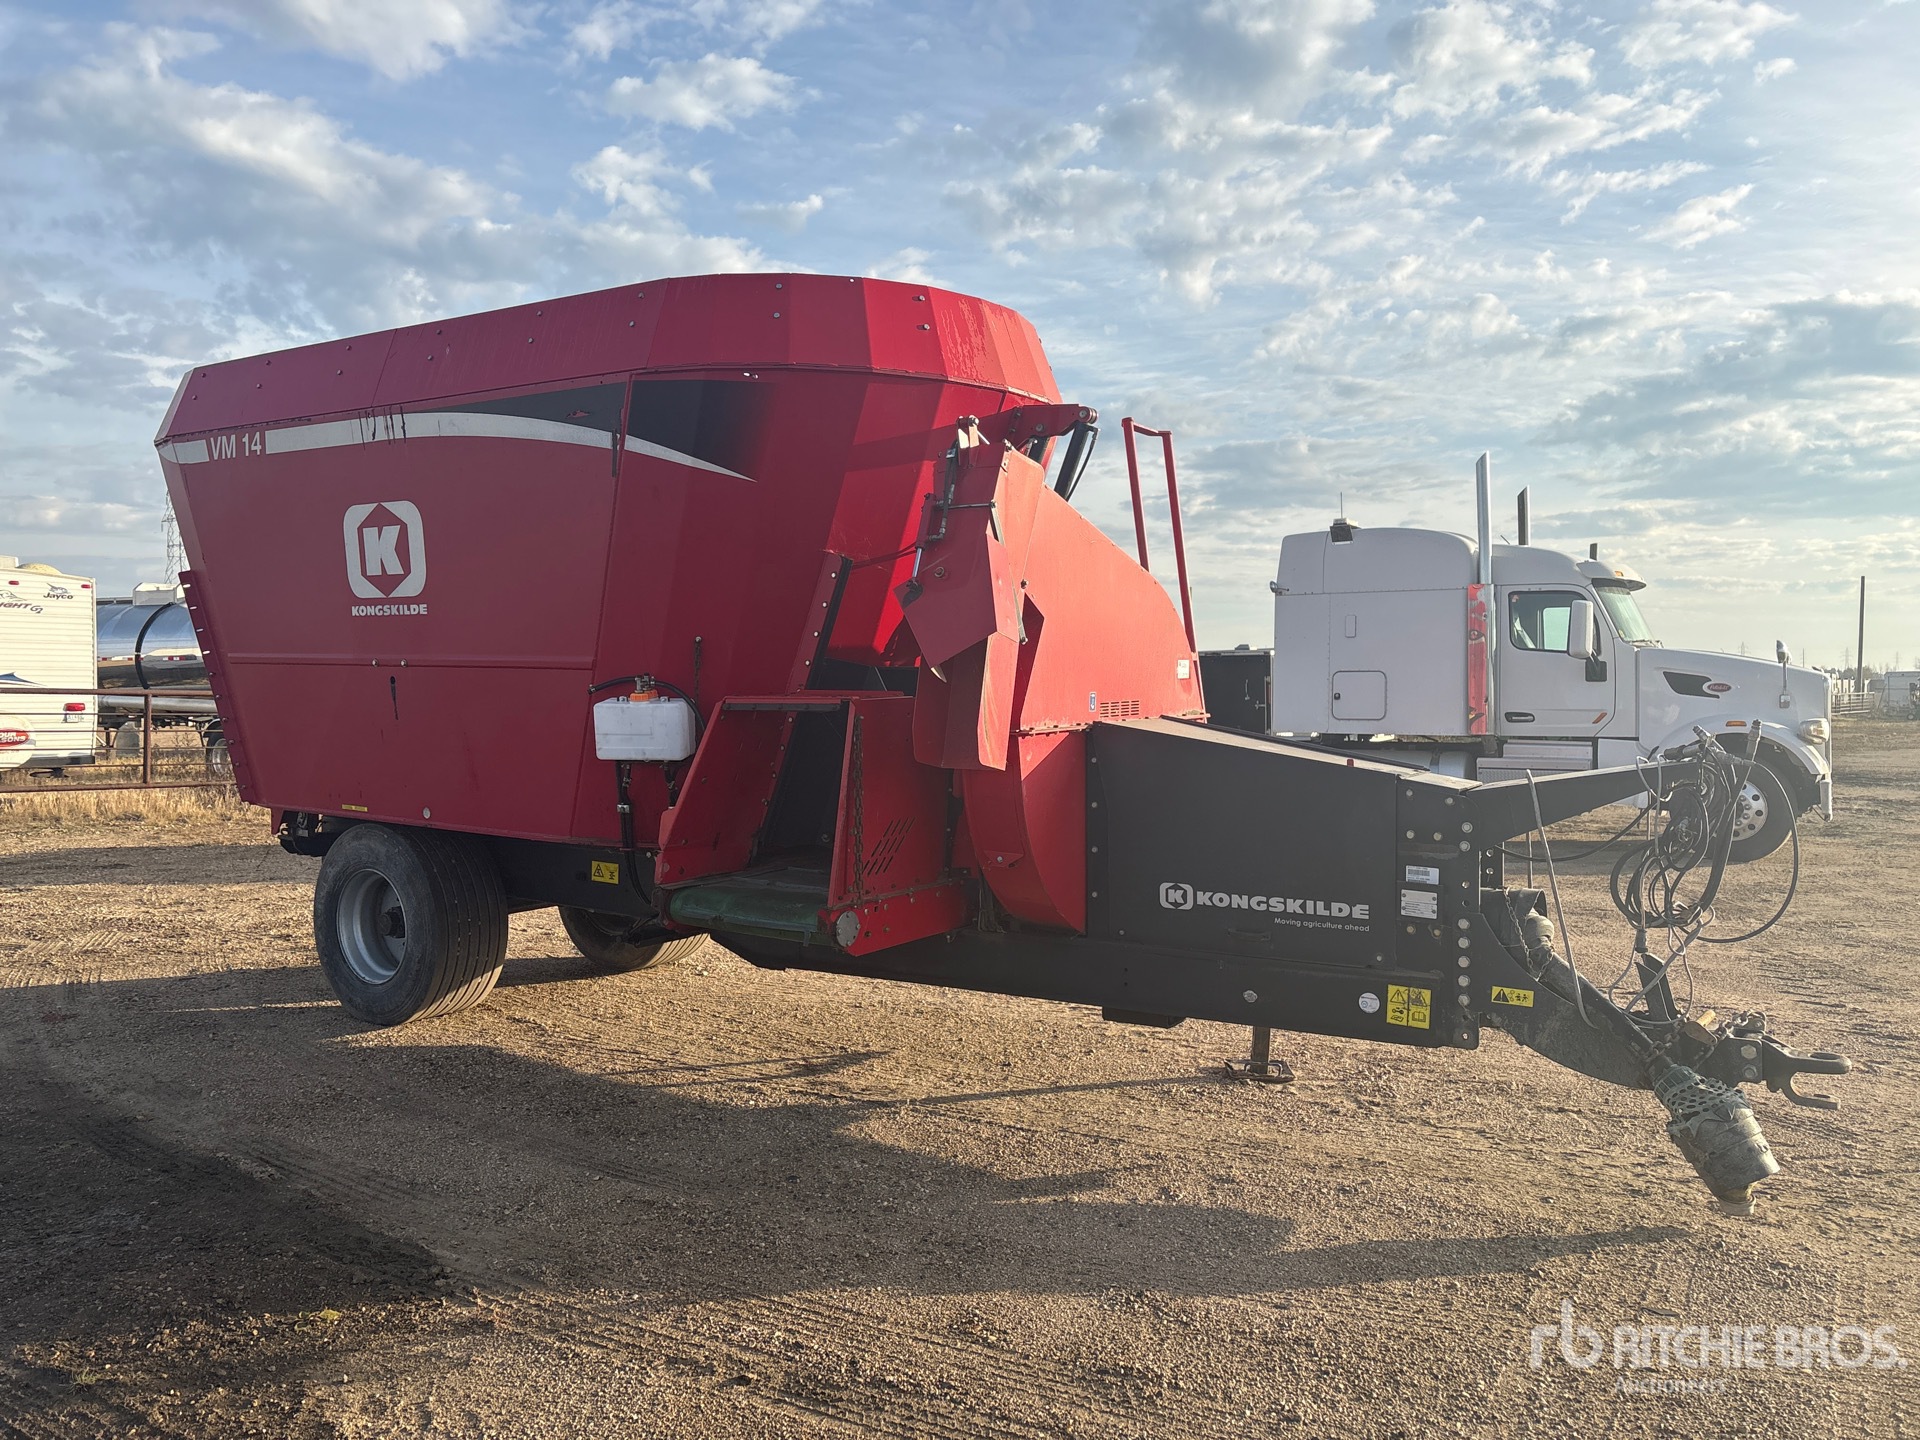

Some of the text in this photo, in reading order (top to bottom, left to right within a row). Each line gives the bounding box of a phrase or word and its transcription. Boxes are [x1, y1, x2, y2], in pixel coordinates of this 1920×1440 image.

[209, 431, 262, 460] VM 14
[363, 525, 404, 576] K
[43, 592, 74, 600] Jayco
[351, 603, 428, 617] KONGSKILDE
[1196, 890, 1370, 920] KONGSKILDE
[1274, 917, 1370, 932] Moving agriculture ahead
